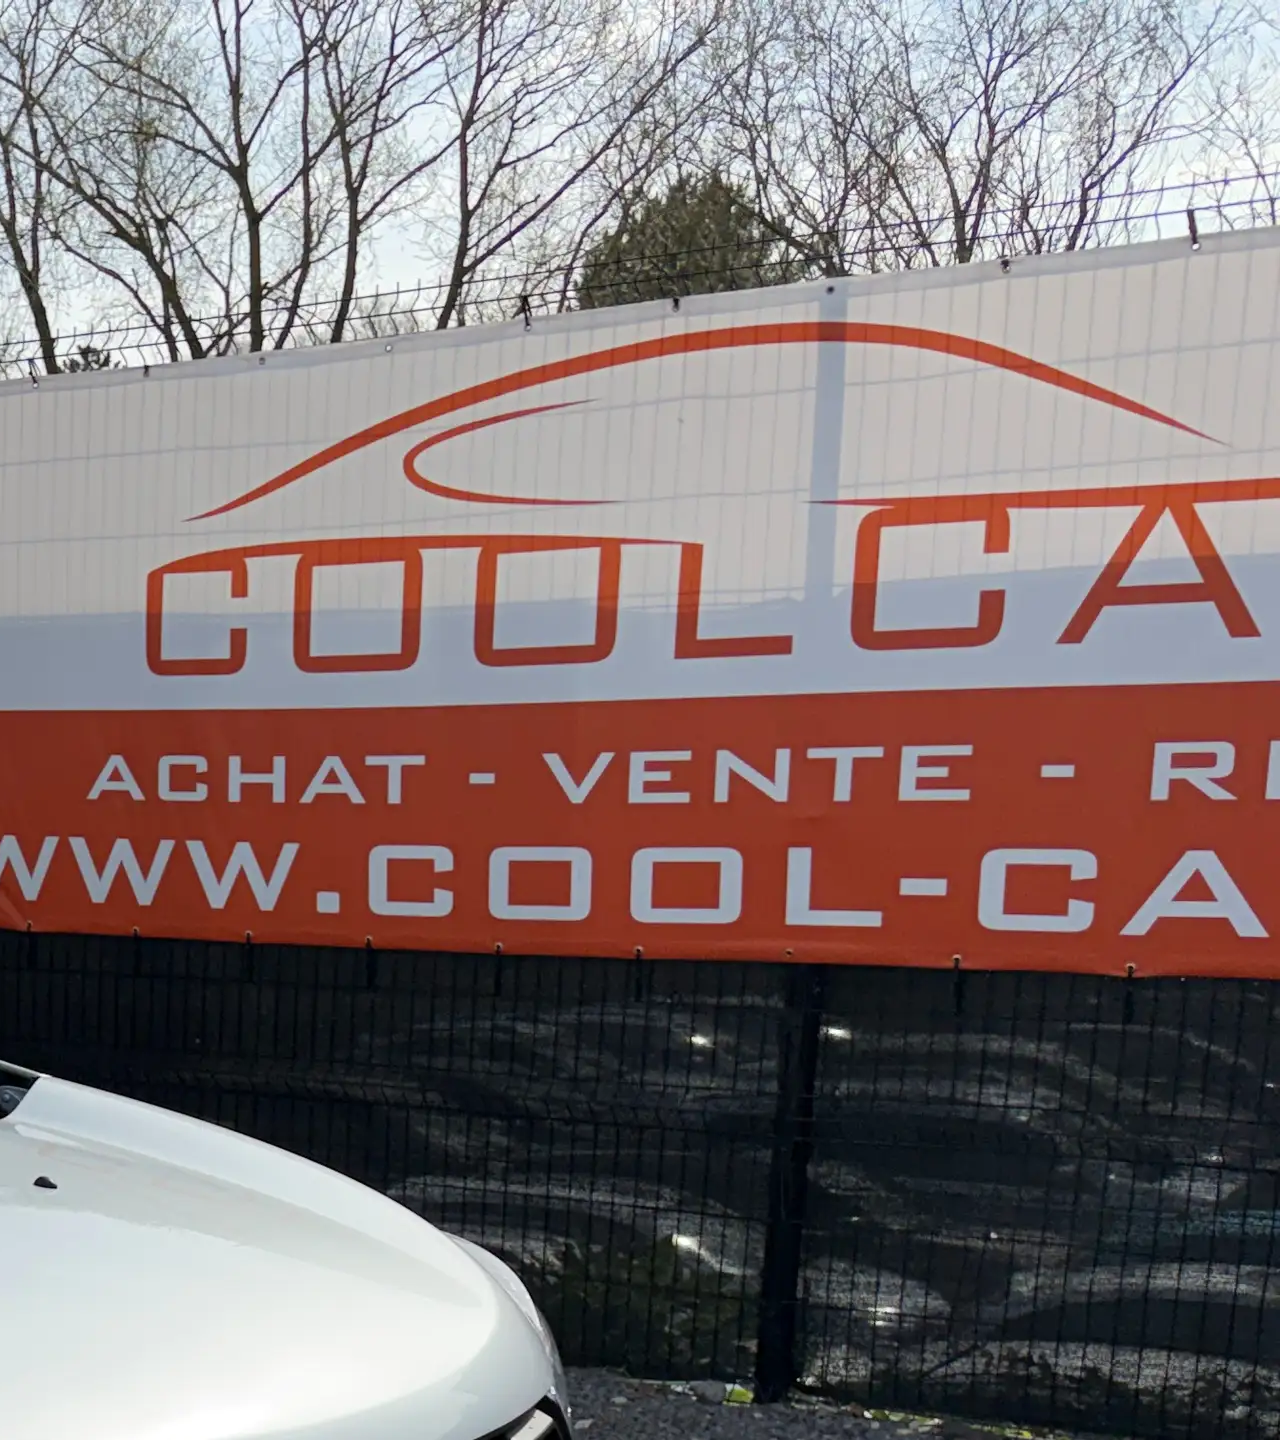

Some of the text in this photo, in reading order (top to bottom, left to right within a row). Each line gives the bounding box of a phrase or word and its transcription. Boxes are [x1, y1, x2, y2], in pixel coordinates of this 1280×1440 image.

[88, 754, 427, 805] ACHAT
[543, 744, 974, 804] VENTE
[1150, 738, 1280, 802] R
